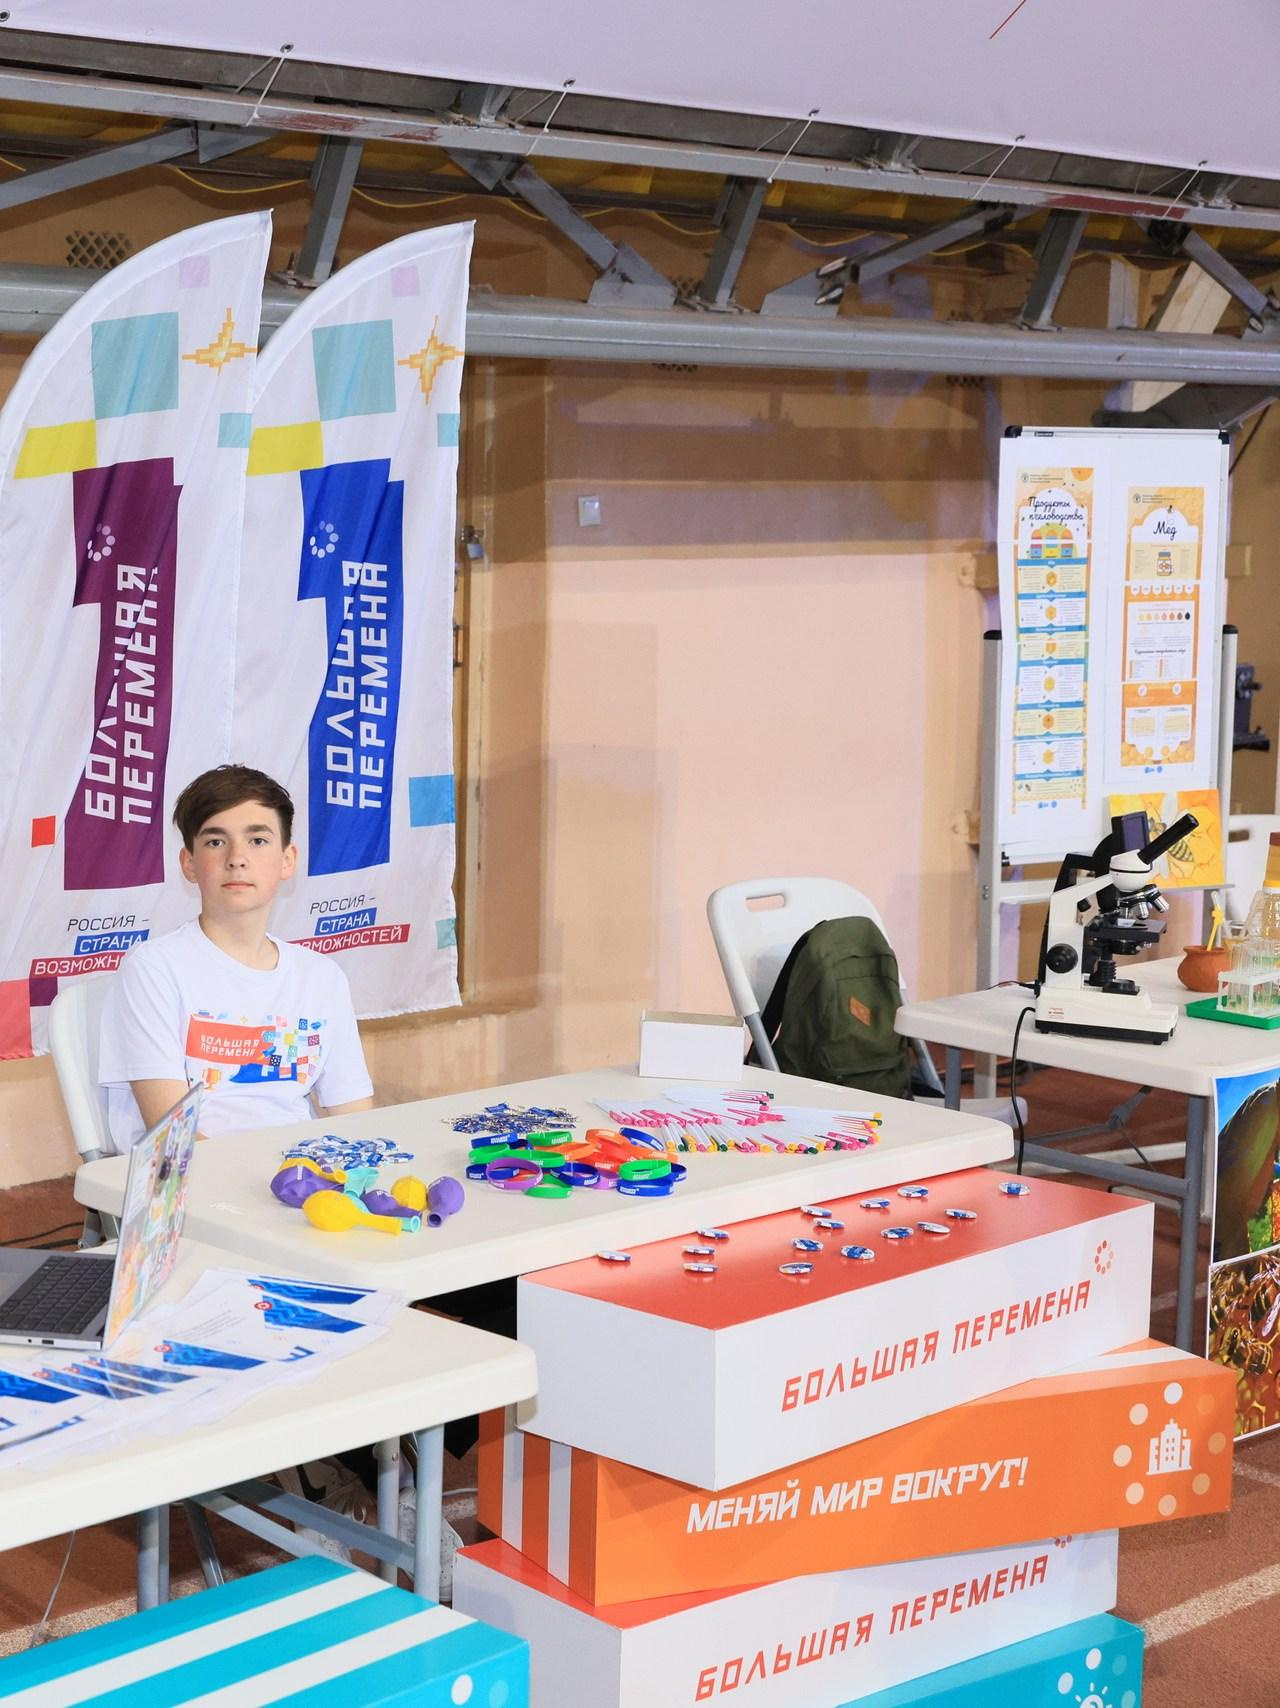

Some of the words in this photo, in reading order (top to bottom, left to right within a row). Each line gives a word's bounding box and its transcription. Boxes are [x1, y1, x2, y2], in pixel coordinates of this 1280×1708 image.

[84, 564, 146, 820] БОЛАЯ
[359, 562, 388, 808] ПЕРЕМЕНА
[67, 915, 136, 932] РОССИЯ
[309, 894, 365, 914] РОССИЯ
[319, 912, 371, 933] СТРАНА
[80, 934, 141, 953] СТРАНА
[200, 1034, 260, 1048] БОЛЬШАЯ
[782, 1330, 939, 1412] БОЛЬШАЯ
[952, 1280, 1091, 1353] ПЕРЕМЕНА
[686, 1479, 801, 1534] МЕНЯЙ
[810, 1477, 884, 1515] МИР
[890, 1457, 1029, 1504] ВОКРУГ!
[695, 1612, 874, 1702] БОЛЬШАЯ
[888, 1554, 1049, 1634] ПЕРЕМЕНА
